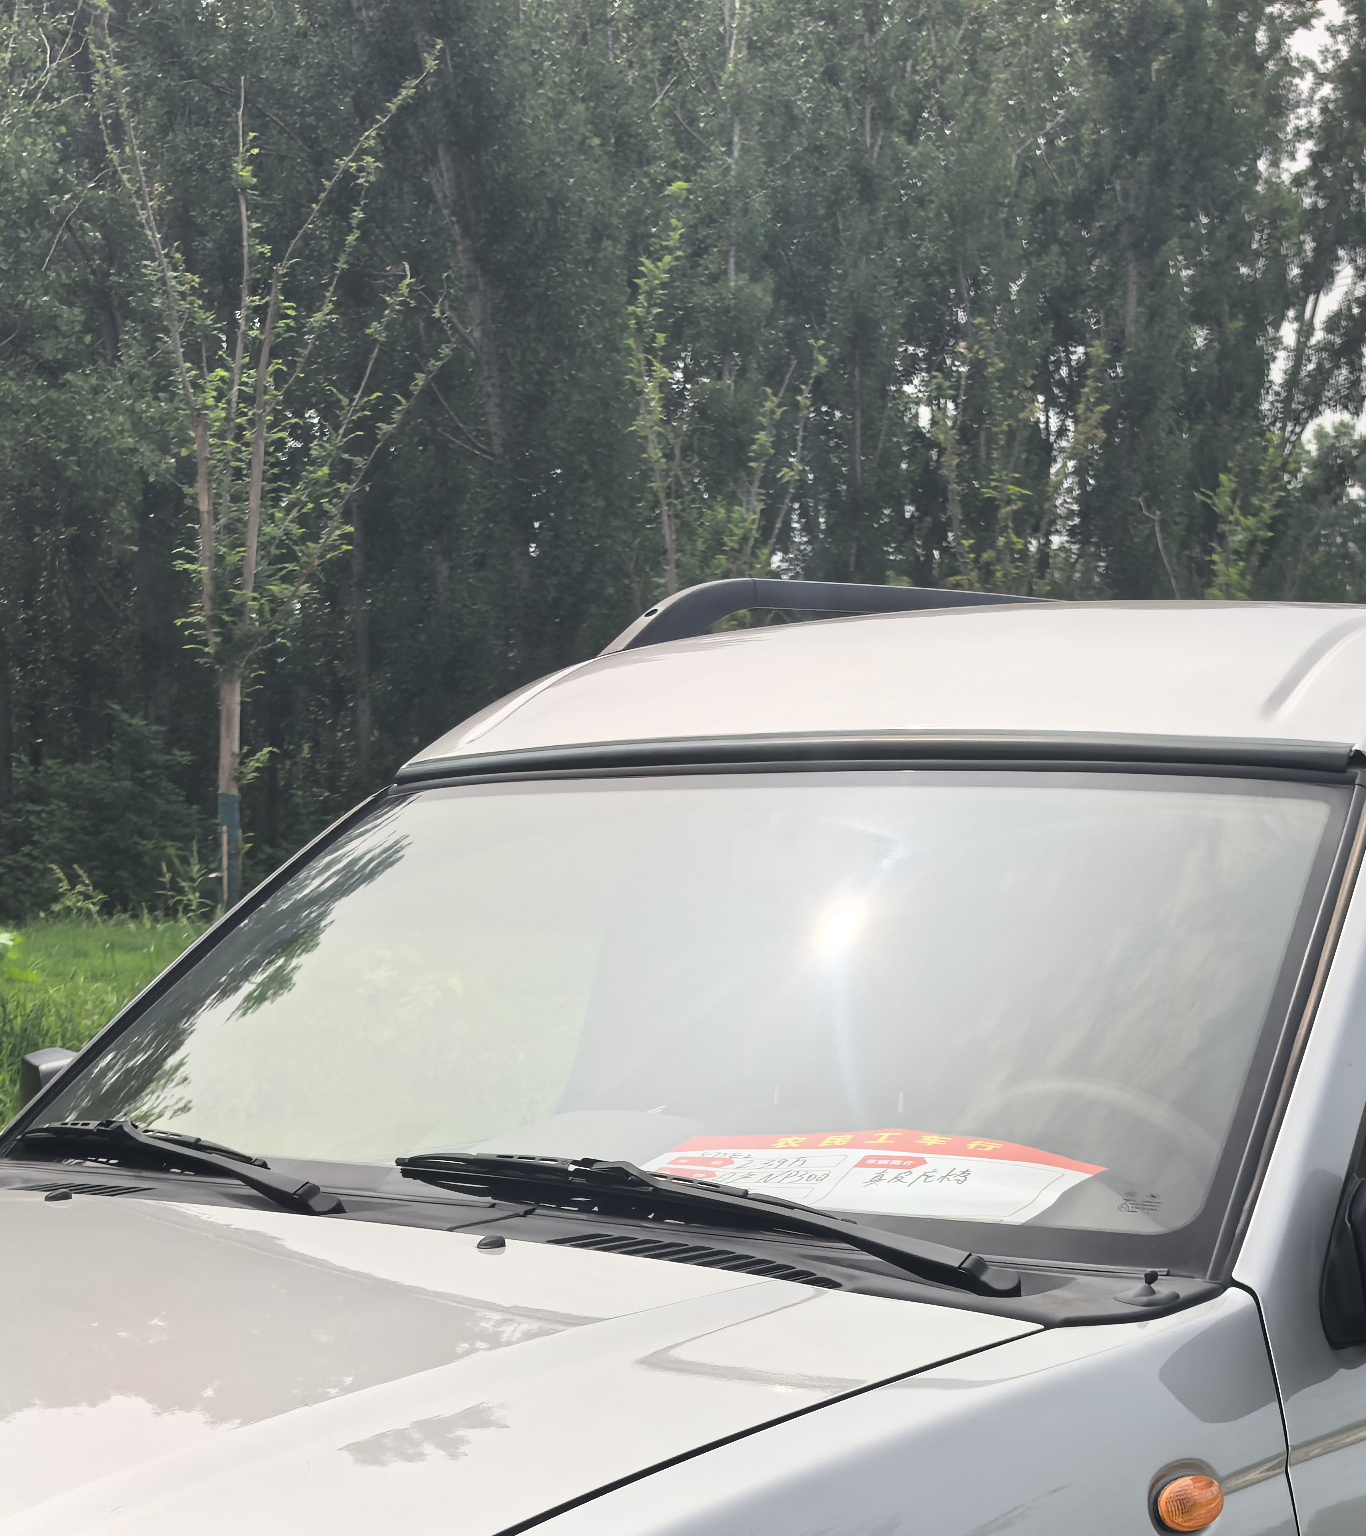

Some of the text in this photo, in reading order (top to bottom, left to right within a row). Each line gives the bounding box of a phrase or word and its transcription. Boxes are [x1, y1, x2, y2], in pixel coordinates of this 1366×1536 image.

[771, 1132, 1003, 1151] 农民工车行
